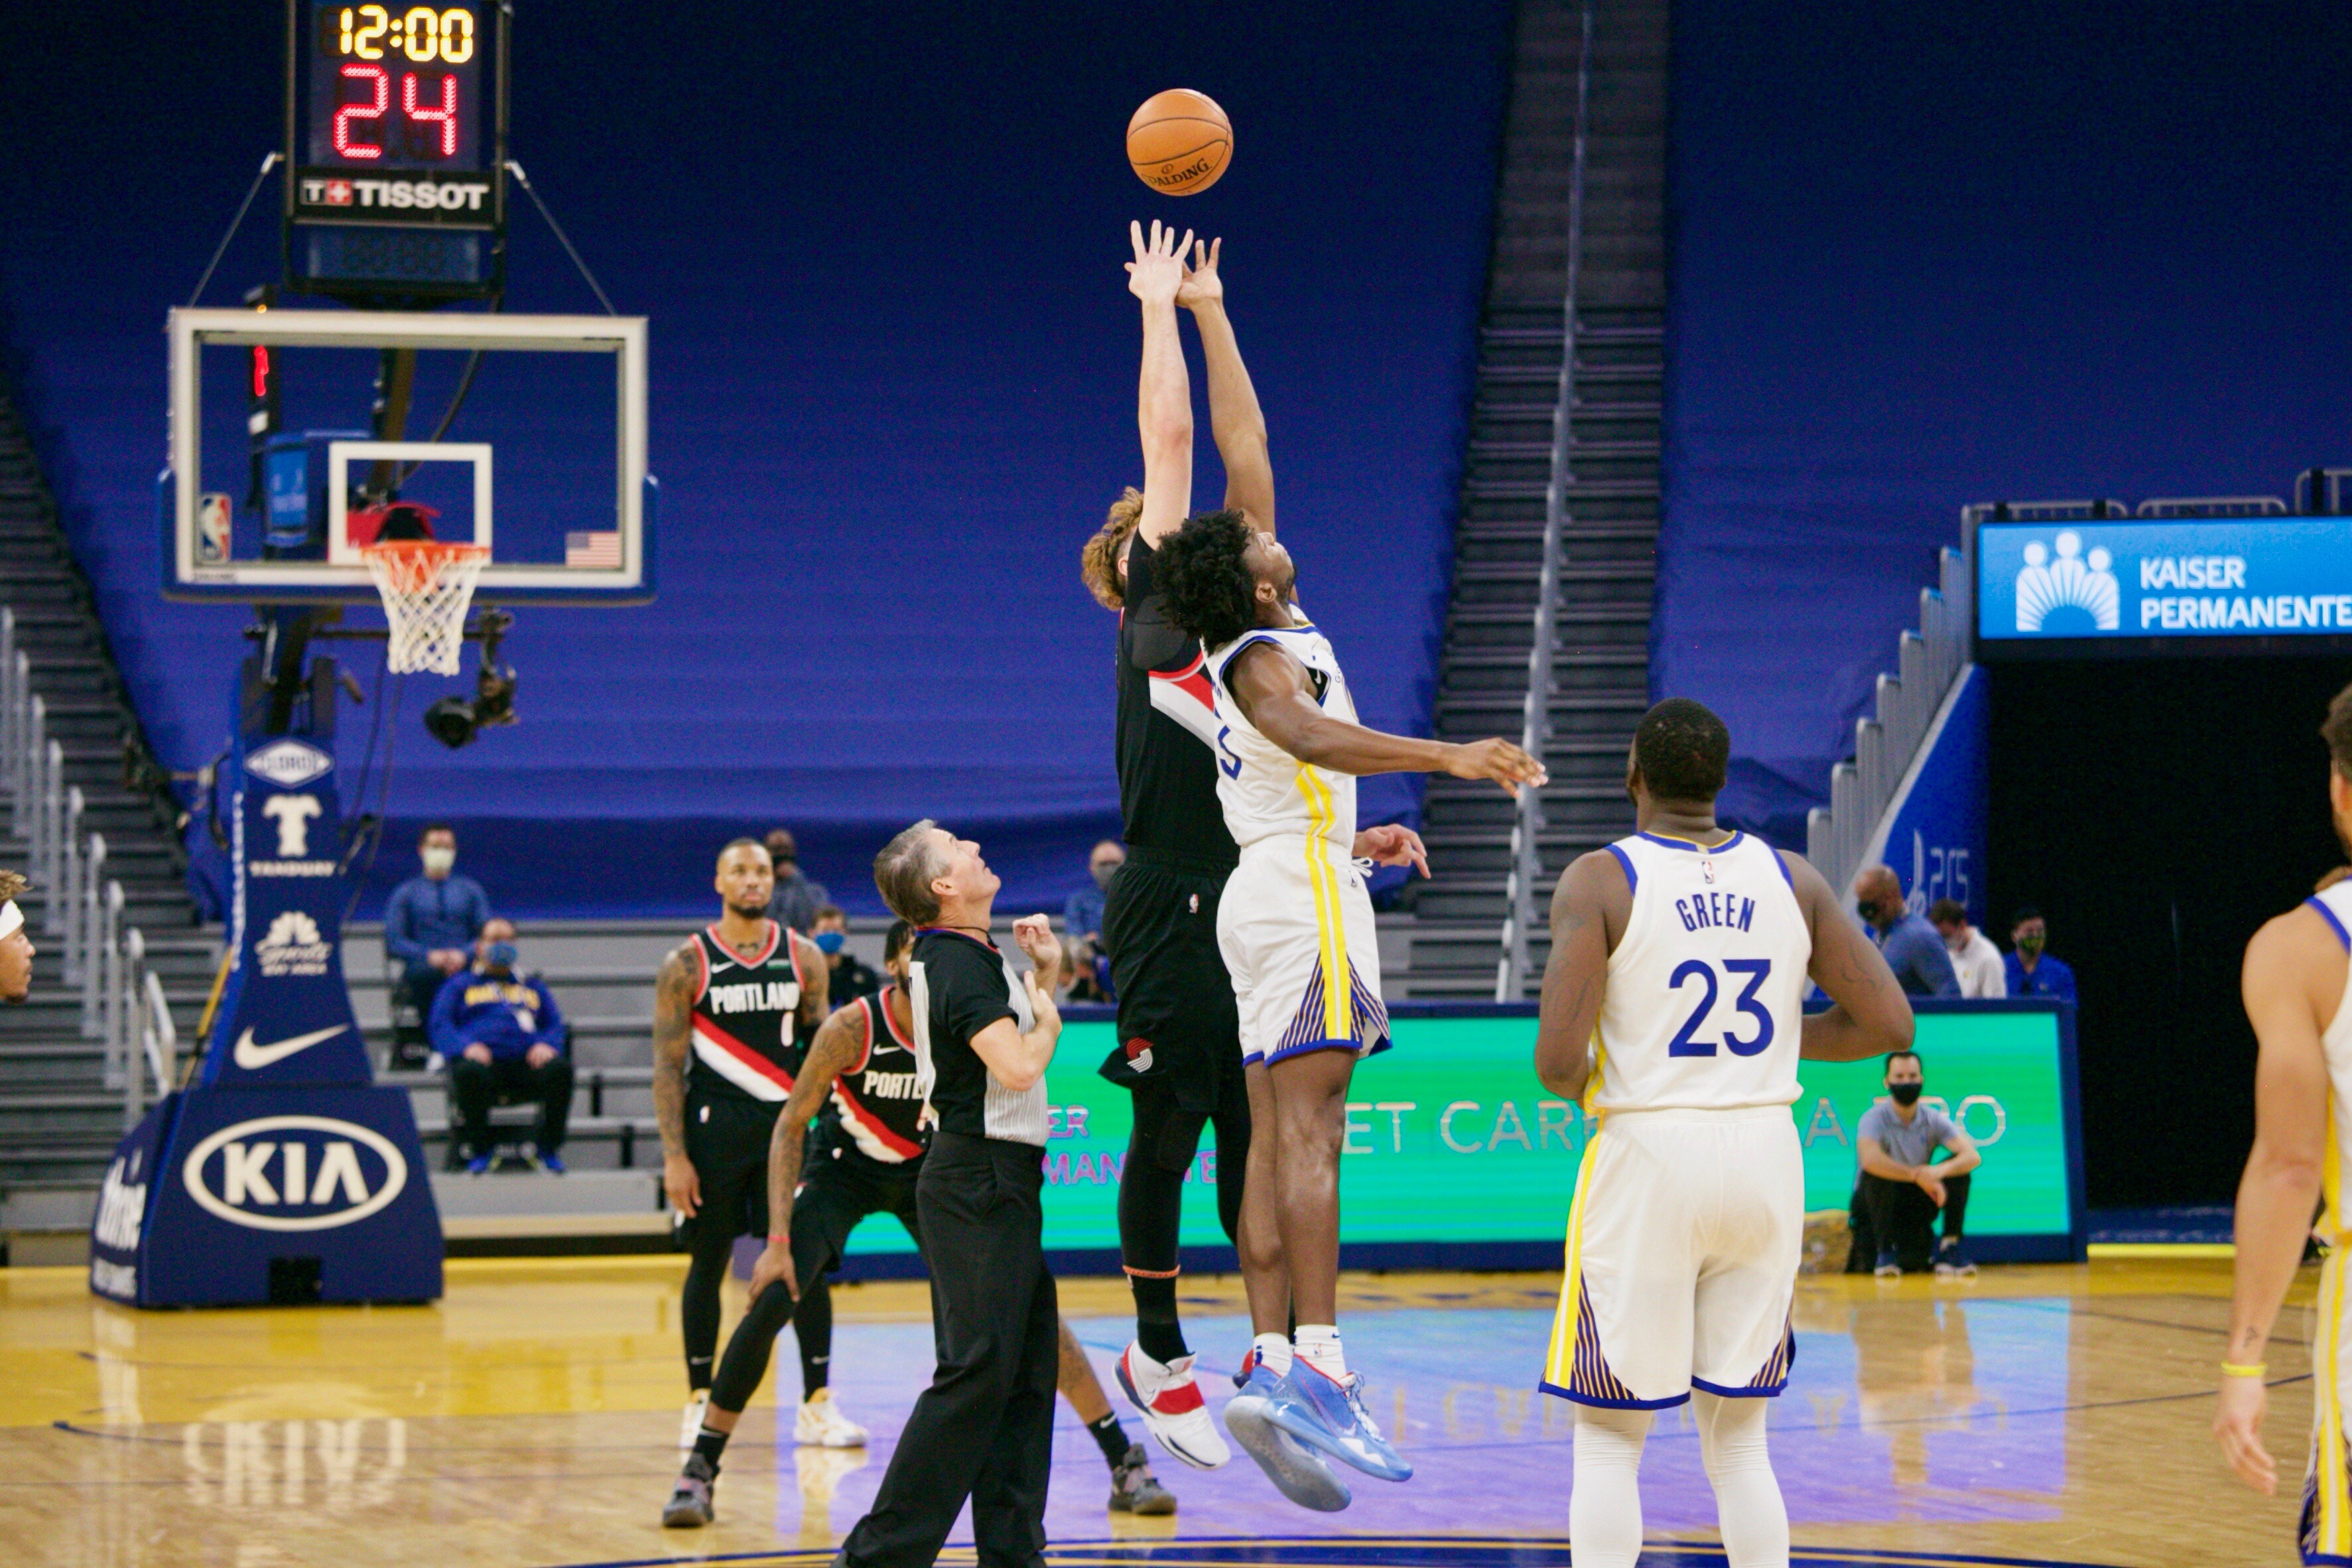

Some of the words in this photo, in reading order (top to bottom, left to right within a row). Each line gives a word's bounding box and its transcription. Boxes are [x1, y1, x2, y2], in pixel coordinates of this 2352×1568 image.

[340, 5, 473, 63] 12:00
[334, 63, 456, 159] 24
[1142, 158, 1209, 186] PALDING
[353, 180, 490, 210] TISSOT
[2140, 557, 2246, 590] KAISER
[2140, 596, 2352, 629] PERMANENTE
[1675, 892, 1756, 933] GREEN
[709, 982, 800, 1015] PORTLAND
[1668, 959, 1774, 1057] 23
[224, 1142, 370, 1205] KIA
